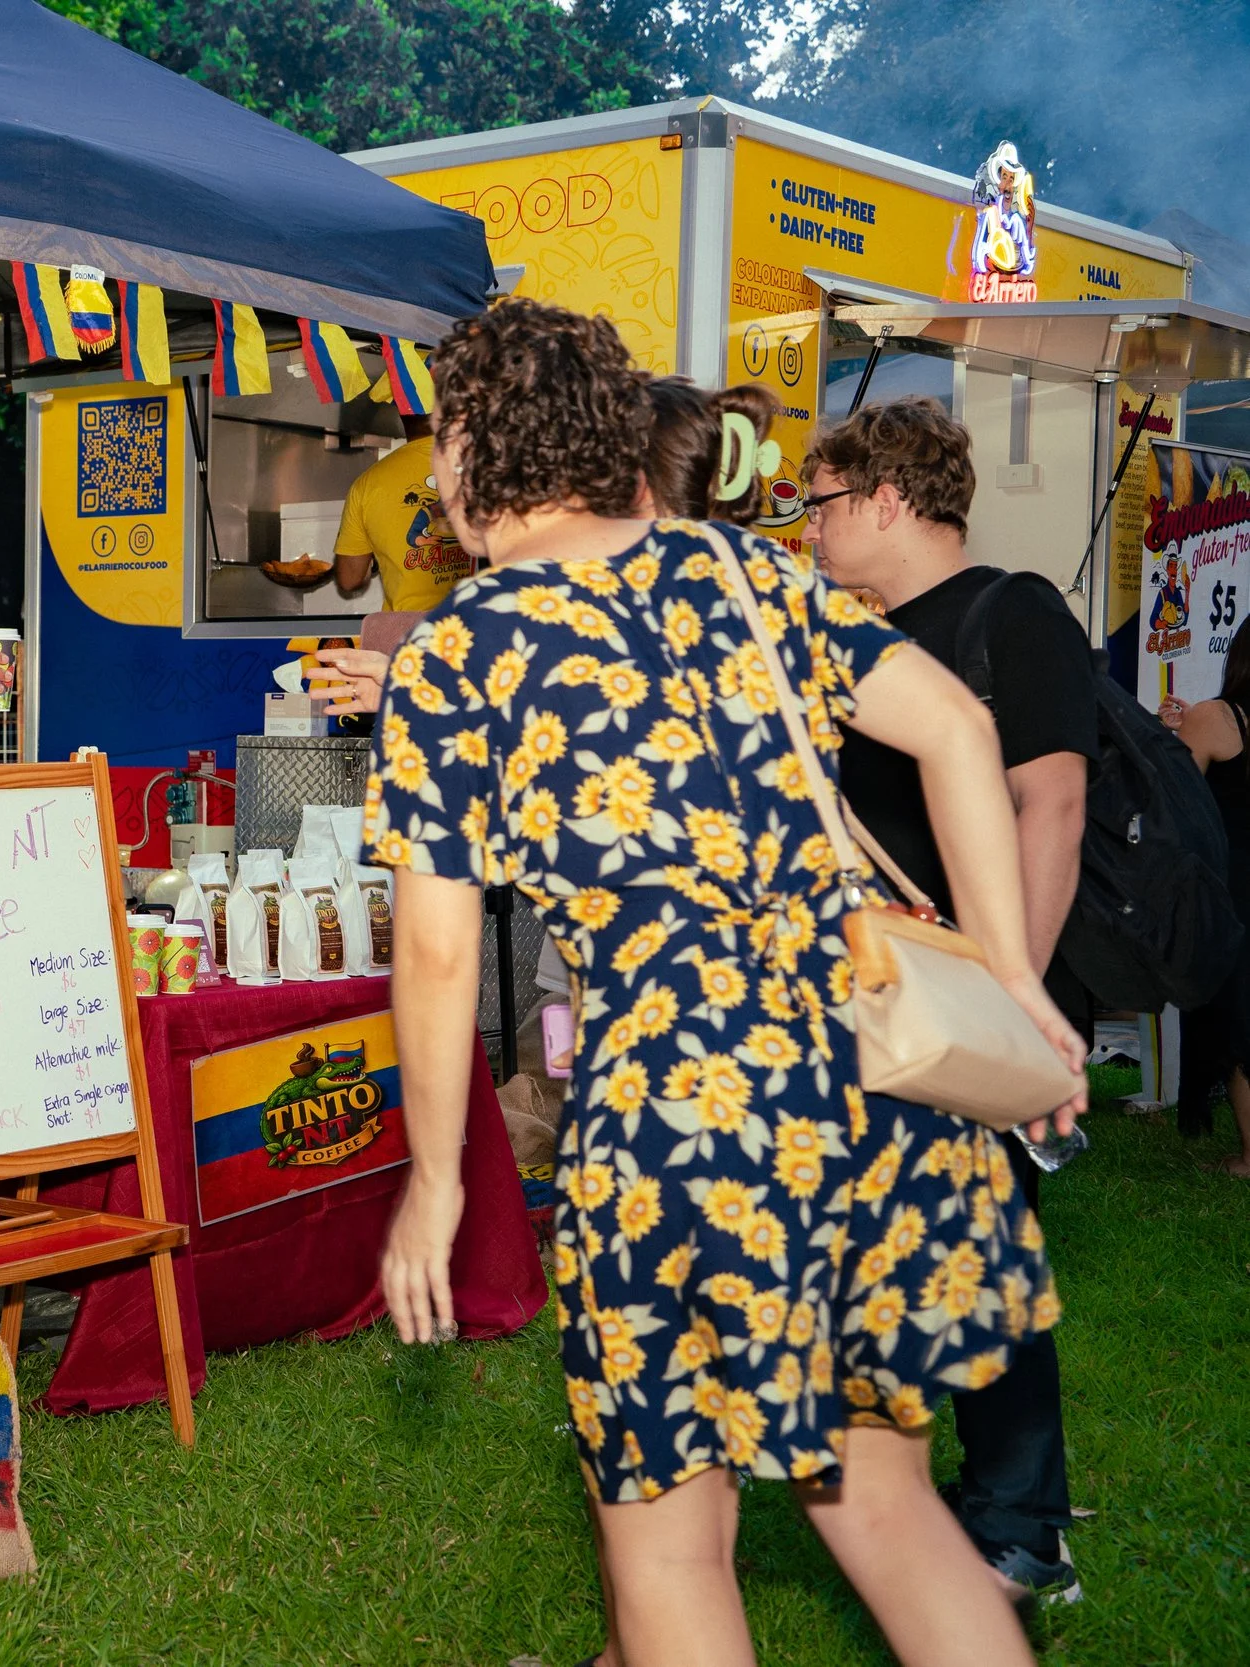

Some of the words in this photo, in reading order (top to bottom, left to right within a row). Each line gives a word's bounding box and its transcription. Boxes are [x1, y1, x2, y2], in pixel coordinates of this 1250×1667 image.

[781, 179, 877, 226] GLUTEN-FREE
[780, 213, 865, 256] DAIRY-FREE
[736, 257, 813, 295] COLOMBIAN
[986, 272, 1037, 303] Arriero
[1088, 265, 1121, 289] HALAL
[78, 561, 168, 572] @ELARRIEROCOLFOOD
[404, 549, 424, 570] El
[1209, 580, 1237, 631] $5
[12, 799, 56, 869] NT
[317, 908, 336, 917] TINTO
[30, 951, 75, 977] Medium
[79, 947, 111, 969] Size:
[61, 971, 77, 993] $6
[39, 1005, 68, 1033] Large
[76, 996, 109, 1016] Size:
[68, 1018, 85, 1039] $7
[35, 1045, 92, 1072] Alternative
[95, 1034, 123, 1057] milk:
[75, 1062, 91, 1082] $1
[44, 1094, 70, 1112] Extra
[74, 1083, 103, 1108] Single
[267, 1083, 376, 1135] TINTO
[47, 1110, 74, 1129] Shot:
[84, 1108, 101, 1129] $1
[302, 1115, 351, 1150] NT
[302, 1137, 362, 1163] COFFEE
